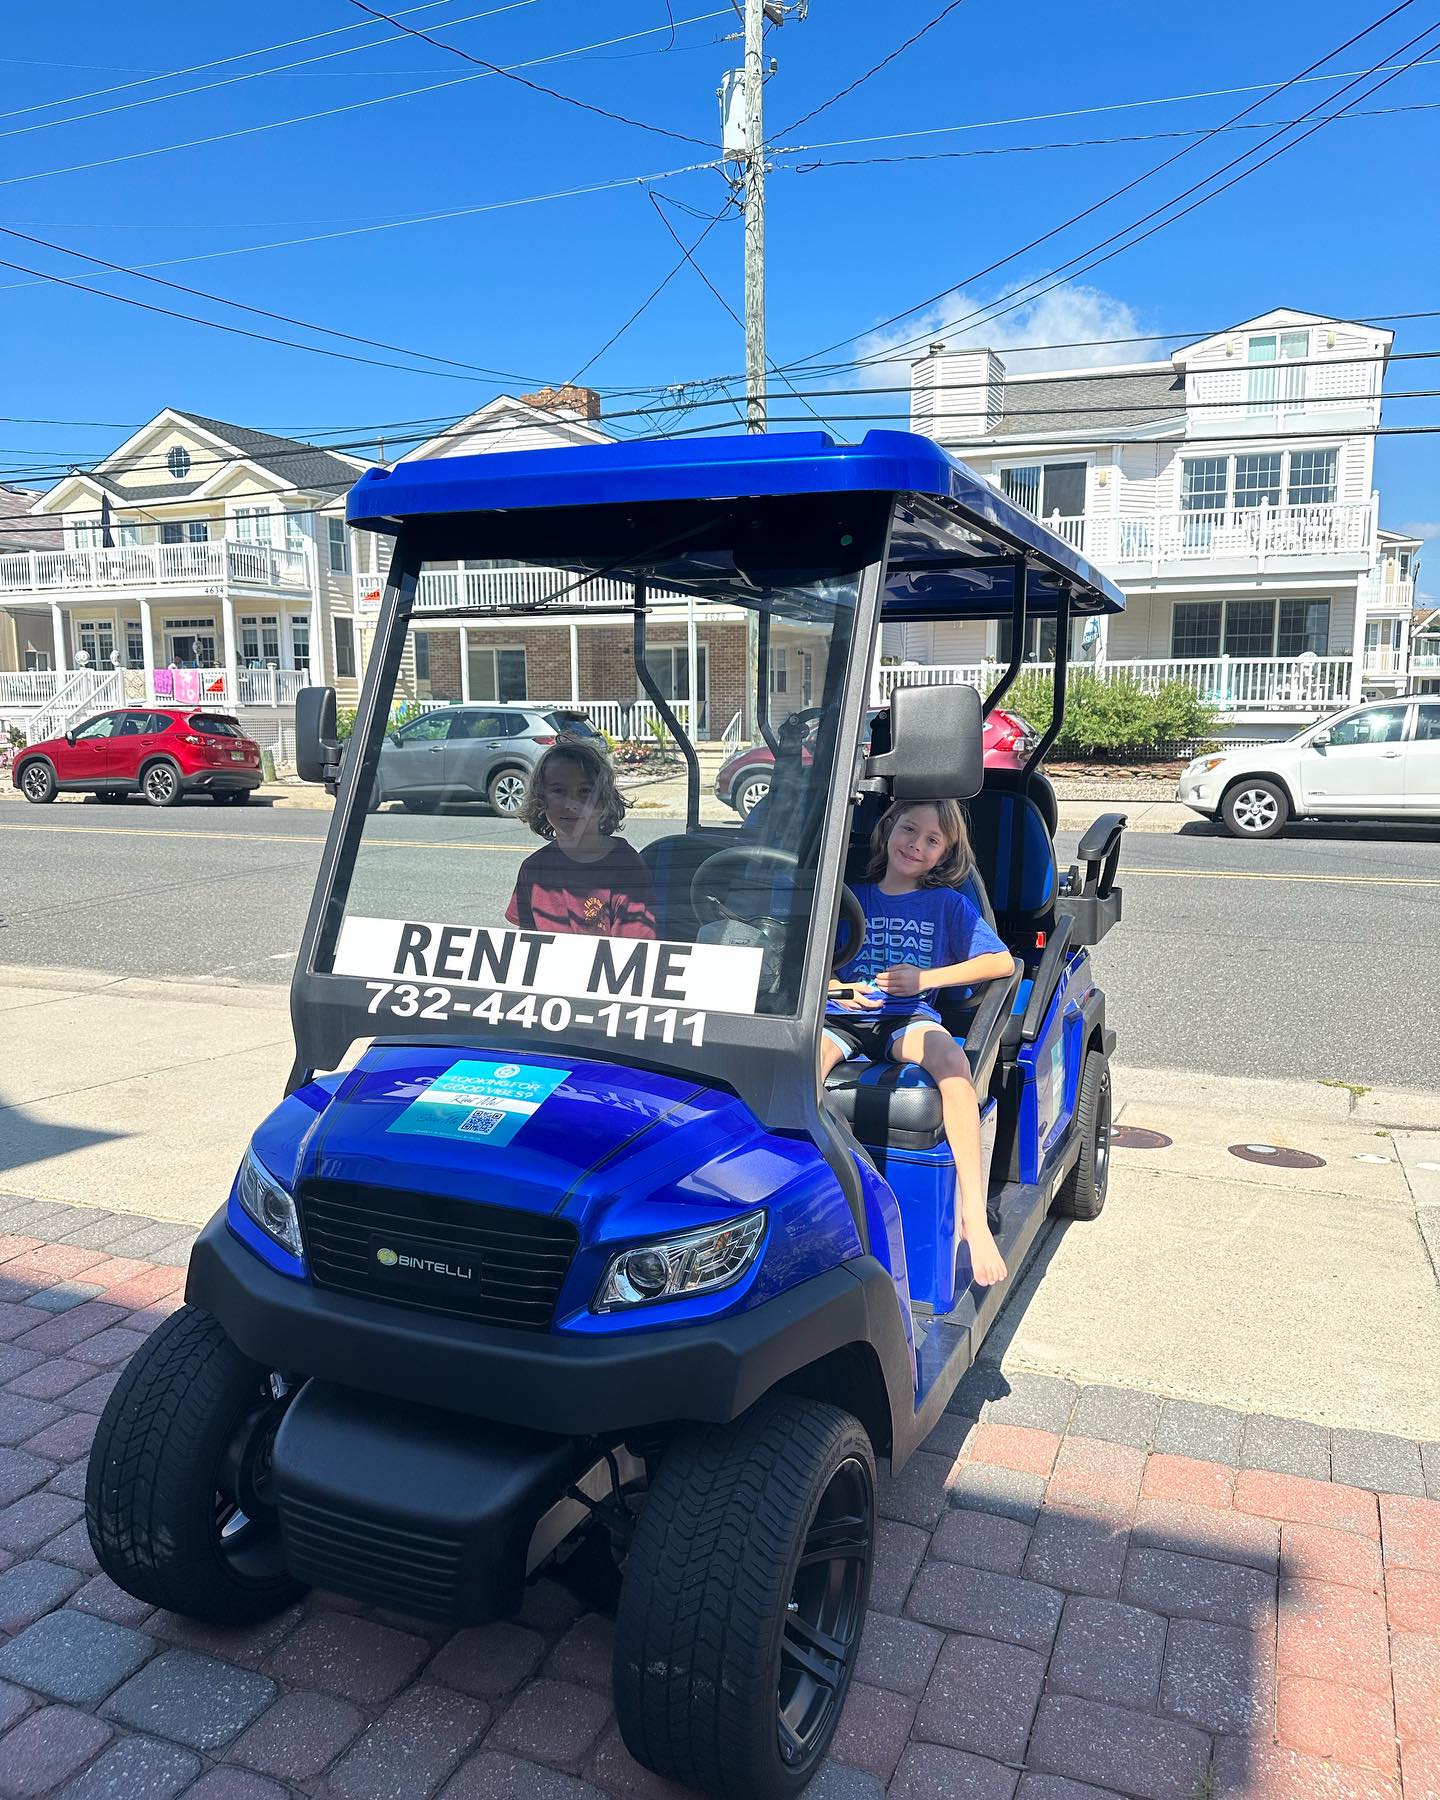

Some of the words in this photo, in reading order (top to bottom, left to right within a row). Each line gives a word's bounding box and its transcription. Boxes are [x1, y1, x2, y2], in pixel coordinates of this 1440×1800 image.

[393, 923, 556, 987] RENT
[586, 939, 693, 1001] ME
[855, 948, 932, 969] ADIDAS
[365, 981, 707, 1048] 732-440-1111
[442, 1083, 484, 1093] GOOD
[487, 1087, 533, 1099] VIBES?
[451, 1076, 508, 1087] LOOKING
[509, 1081, 540, 1091] FOR
[398, 1254, 472, 1279] BINTELLI
